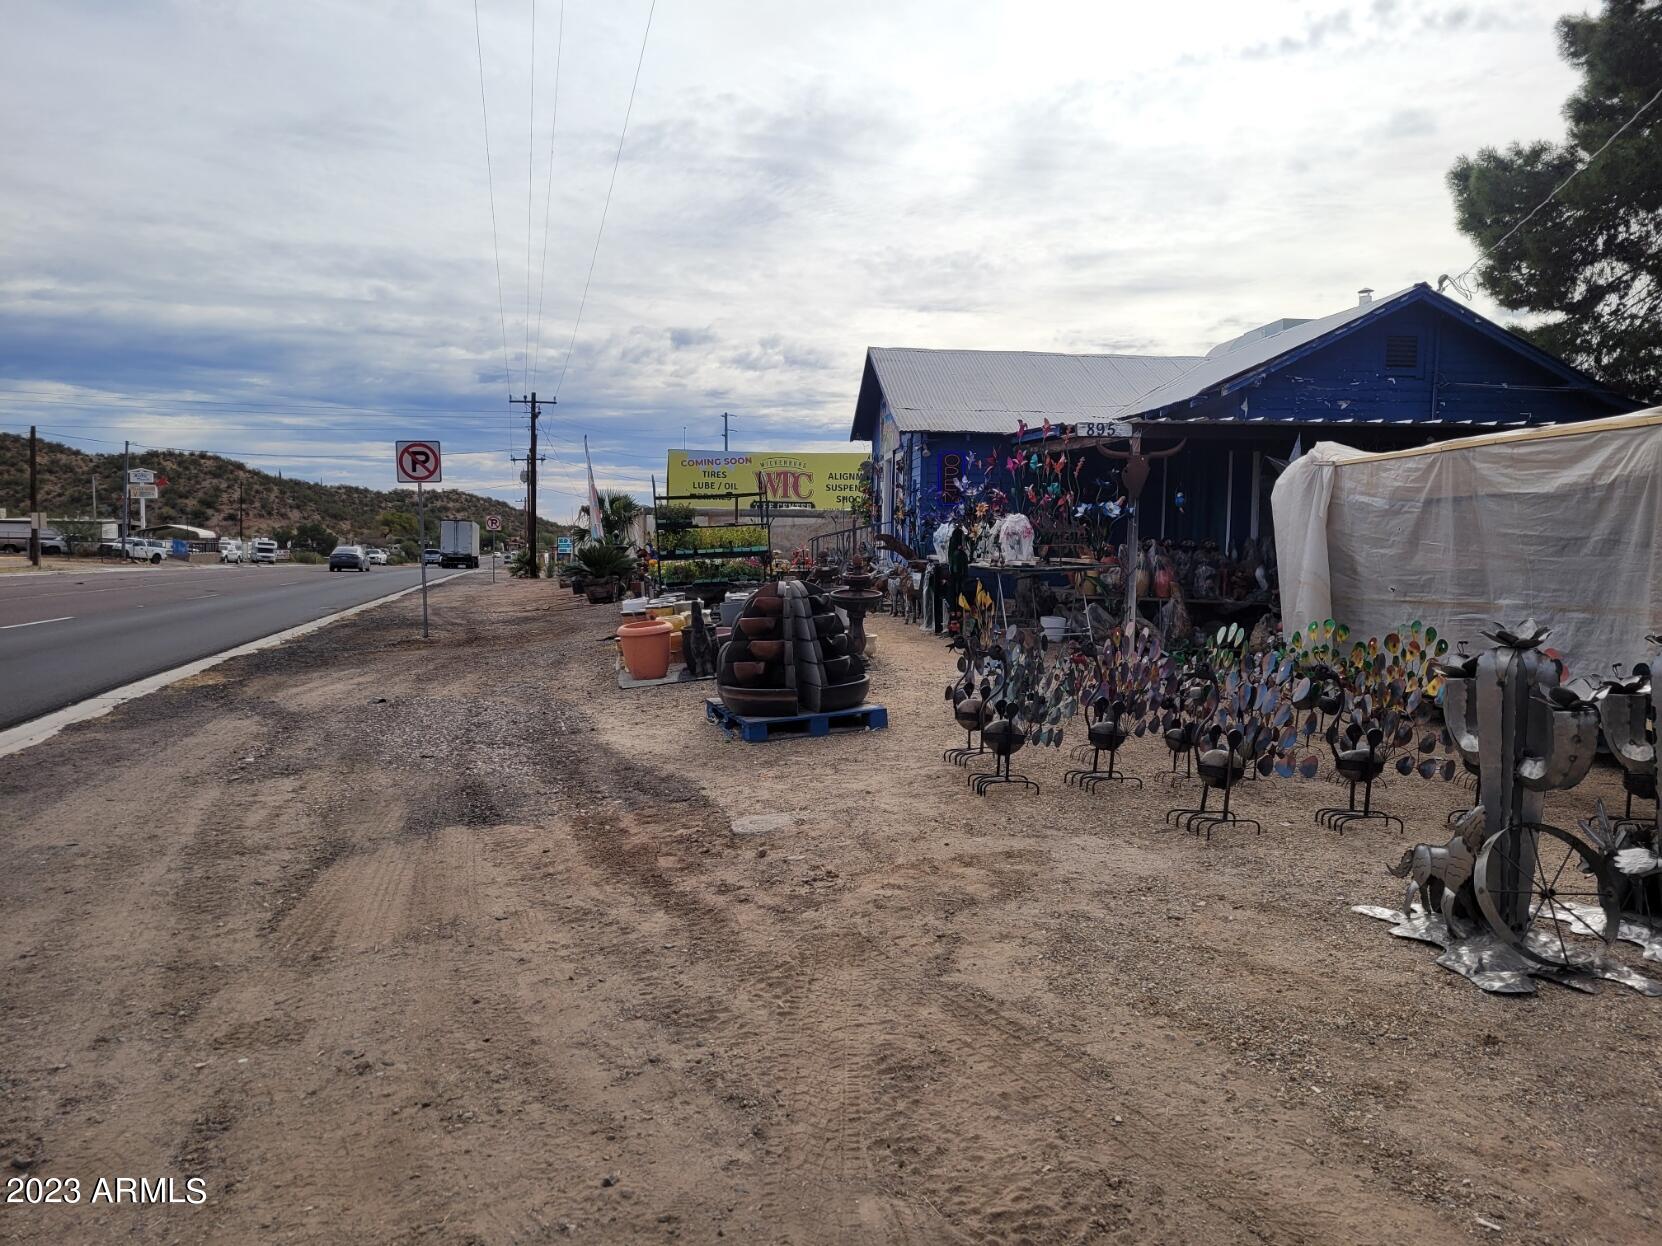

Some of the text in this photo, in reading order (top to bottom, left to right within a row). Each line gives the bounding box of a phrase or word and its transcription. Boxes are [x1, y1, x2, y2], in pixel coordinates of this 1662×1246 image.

[1087, 422, 1115, 436] 895
[681, 457, 752, 467] COMING SOON
[703, 471, 727, 479] TIRES
[828, 472, 862, 480] ALIGNM
[724, 482, 738, 490] OIL
[836, 495, 862, 503] SHOC
